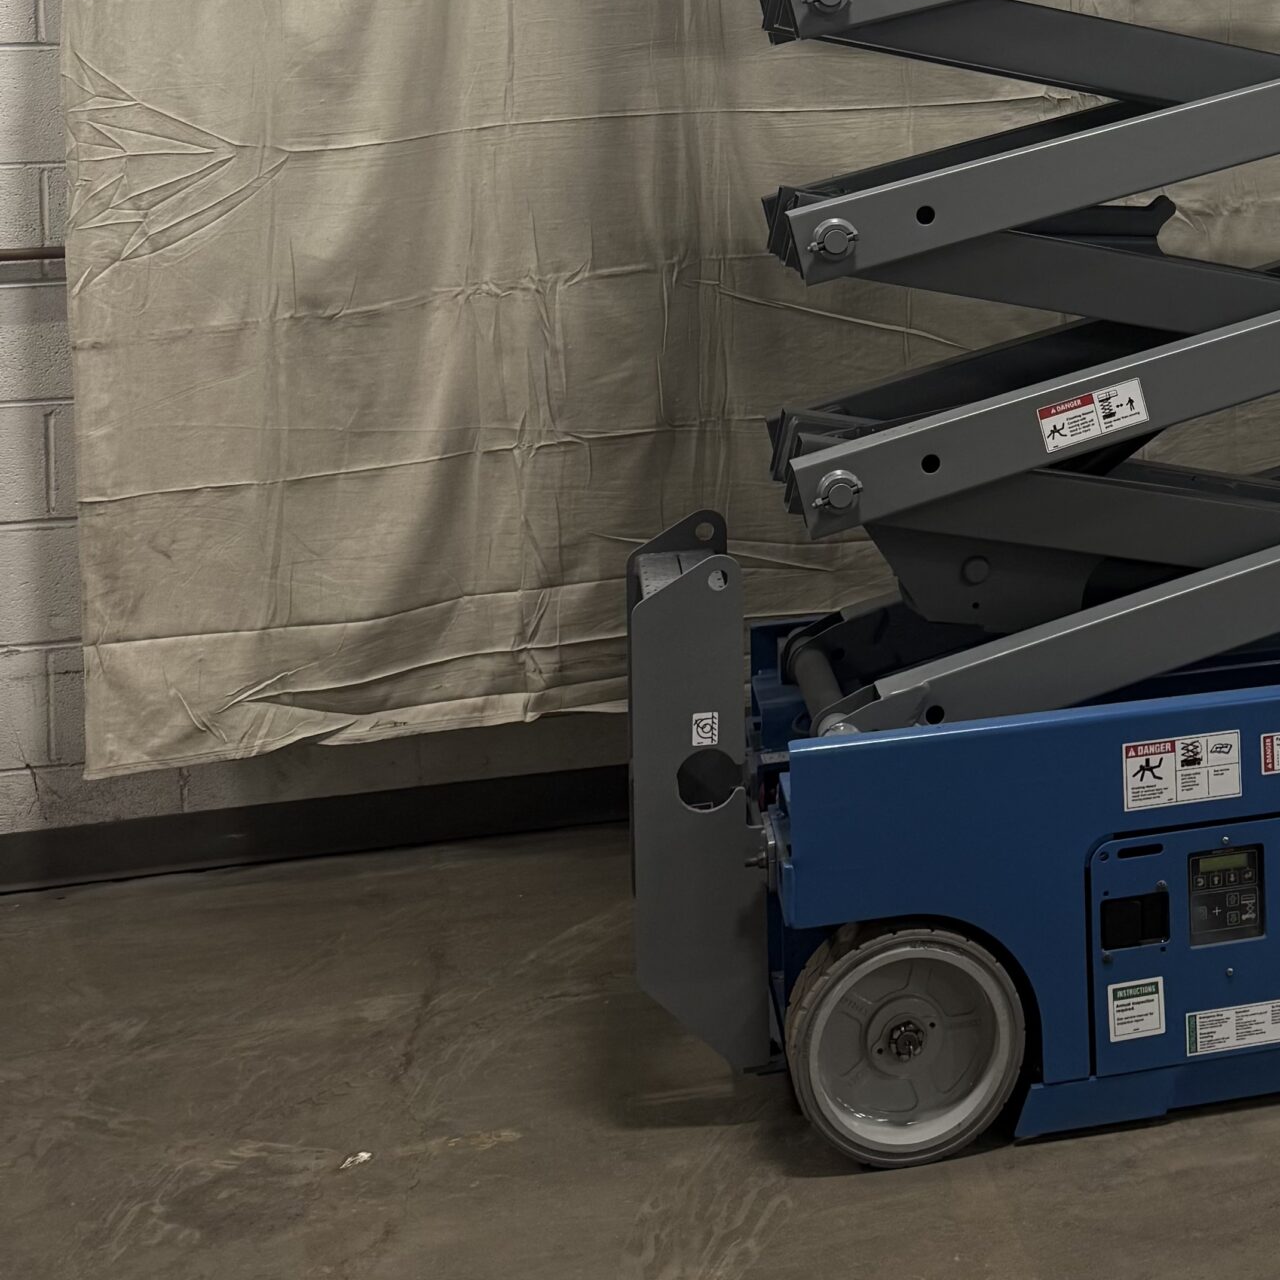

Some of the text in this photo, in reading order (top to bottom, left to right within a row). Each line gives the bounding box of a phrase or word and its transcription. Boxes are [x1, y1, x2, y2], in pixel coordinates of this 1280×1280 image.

[1057, 399, 1081, 413] DANGER
[1138, 742, 1171, 755] DANGER
[1117, 984, 1156, 998] INSTRUCTIONS
